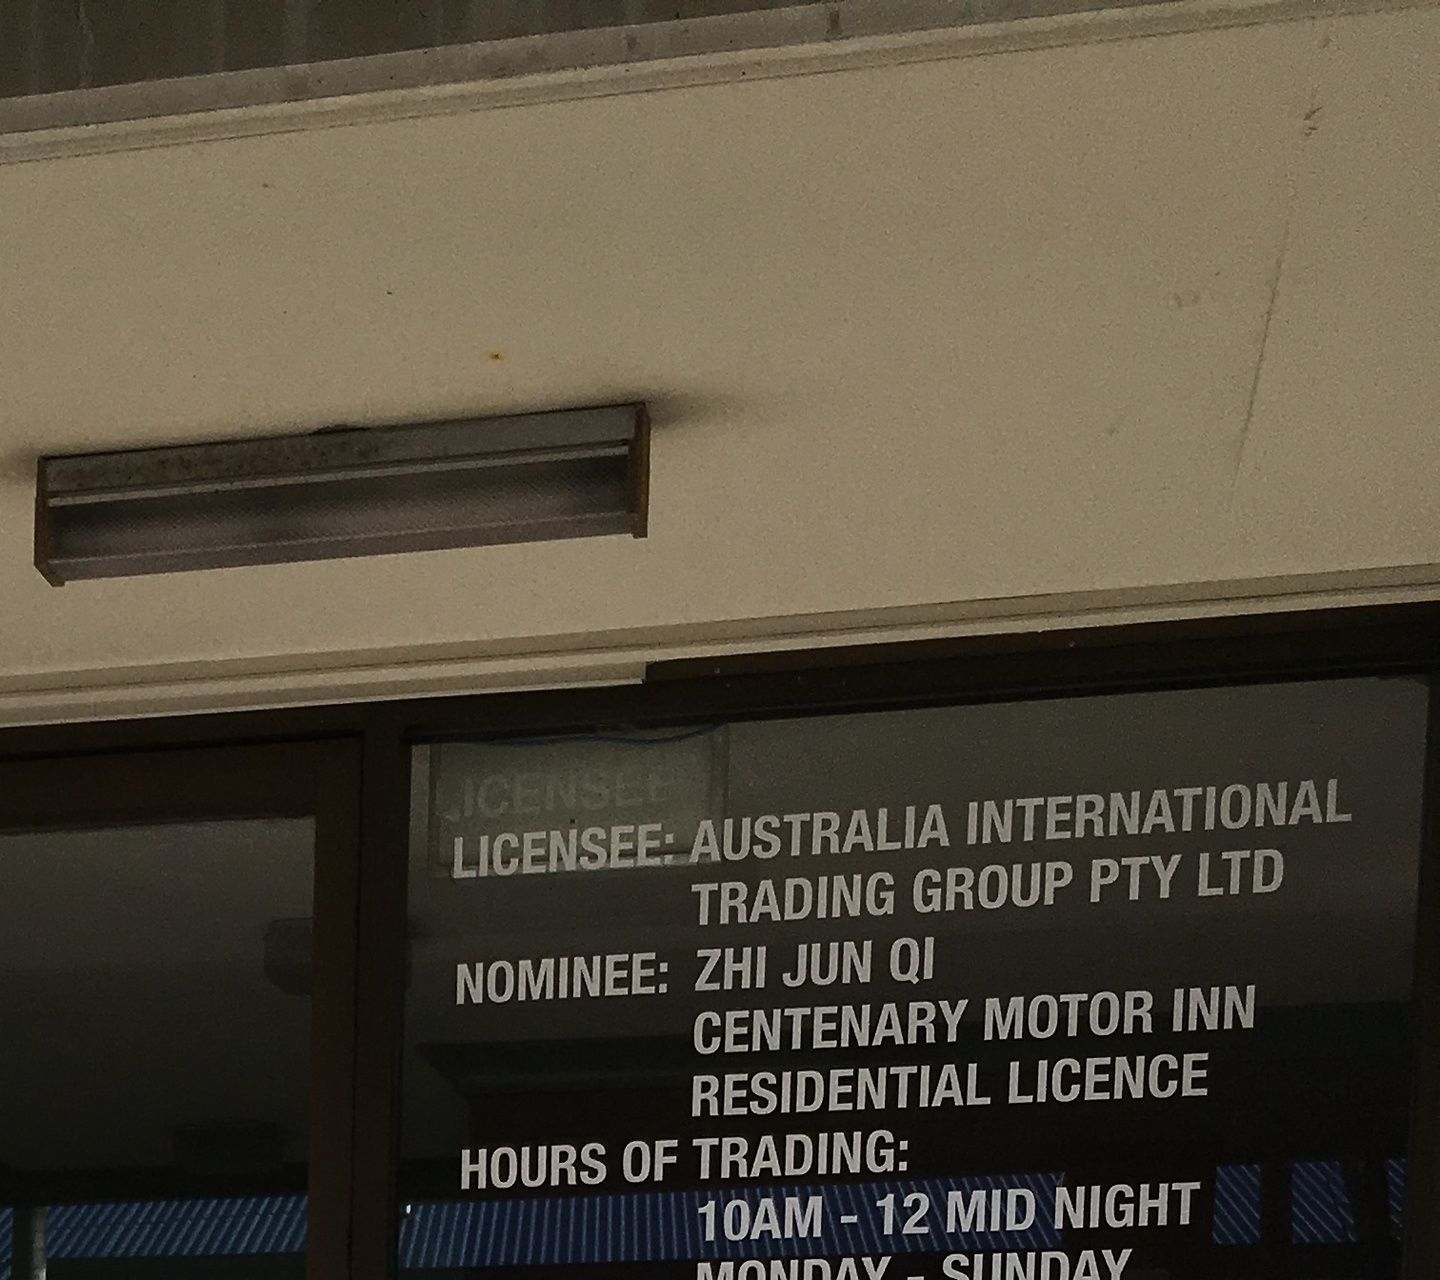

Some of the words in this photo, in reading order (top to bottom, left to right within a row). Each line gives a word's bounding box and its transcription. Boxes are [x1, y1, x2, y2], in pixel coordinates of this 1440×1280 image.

[452, 822, 675, 879] LICENSEE:
[690, 804, 951, 865] AUSTRALIA
[966, 778, 1352, 846] INTERNATIONAL
[692, 869, 896, 926] TRADING
[912, 858, 1073, 915] GROUP
[1091, 854, 1182, 902] PTY
[1197, 848, 1284, 897] LTD
[455, 951, 669, 1004] NOMINEE:
[695, 946, 767, 993] ZHI
[782, 941, 873, 989] JUN
[890, 936, 936, 986] QI
[693, 999, 968, 1058] CENTENARY
[983, 990, 1155, 1043] MOTOR
[1172, 985, 1258, 1032] INN
[691, 1064, 991, 1118] RESIDENTIAL
[1008, 1053, 1209, 1106] LICENCE
[460, 1142, 606, 1190] HOURS
[623, 1139, 677, 1182] OF
[692, 1129, 909, 1180] TRADING:
[697, 1195, 823, 1243] 10AM
[876, 1191, 928, 1236] 12
[945, 1186, 1037, 1236] MID
[1053, 1182, 1202, 1231] NIGHT
